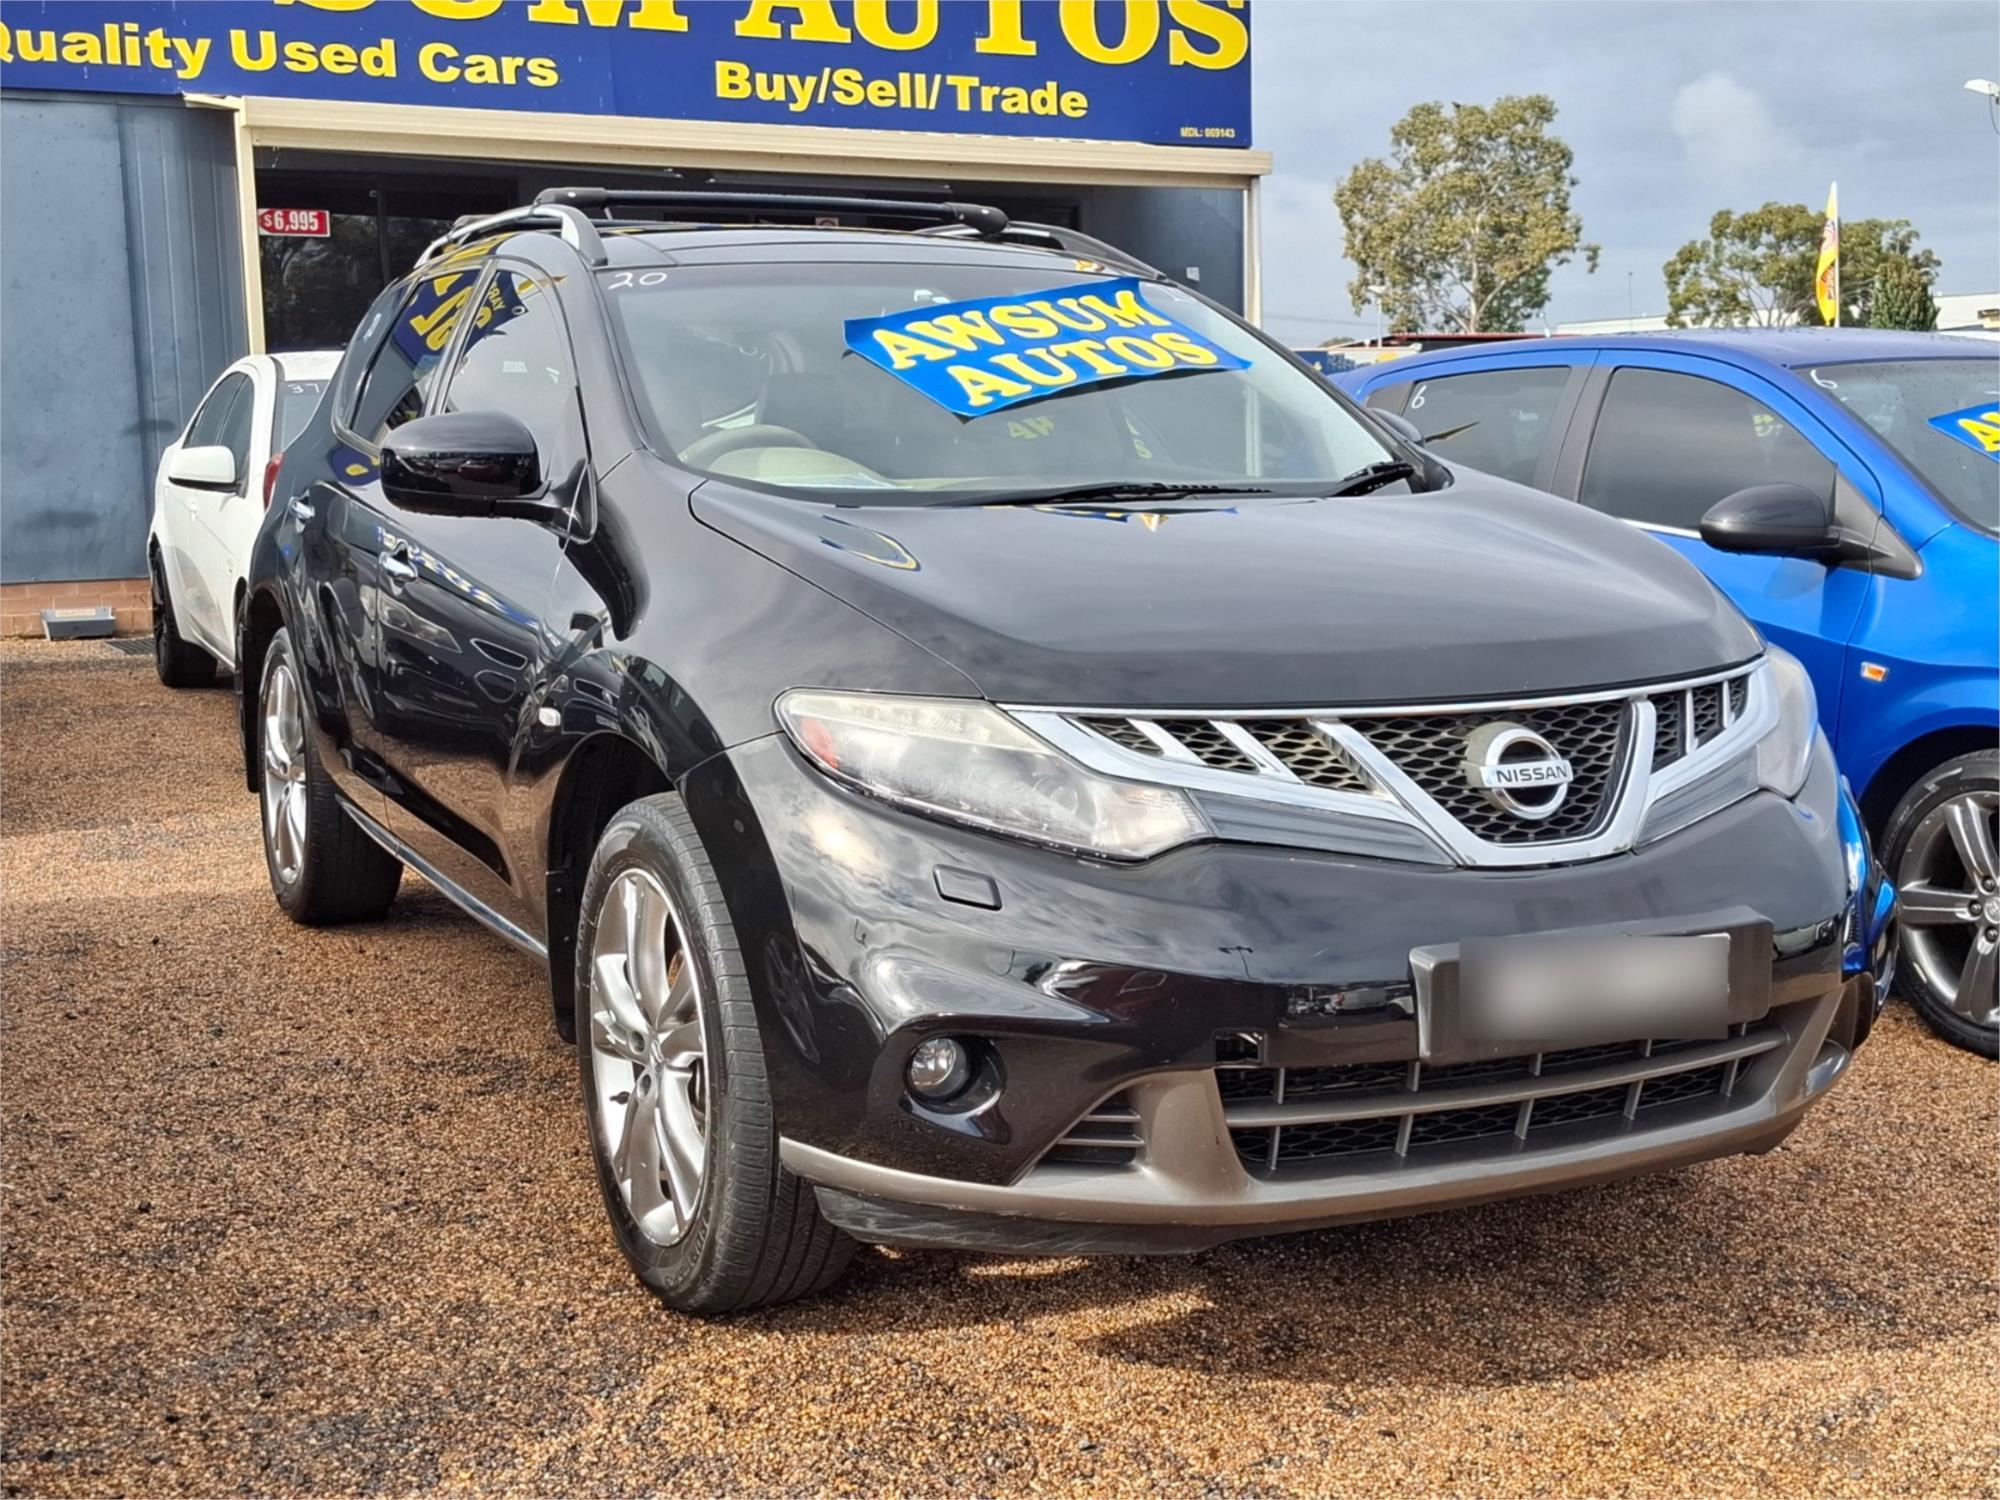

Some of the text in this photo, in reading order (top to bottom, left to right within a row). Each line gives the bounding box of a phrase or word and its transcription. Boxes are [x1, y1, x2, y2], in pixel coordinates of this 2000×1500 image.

[230, 29, 397, 78] Used
[417, 42, 560, 88] Cars
[263, 210, 319, 232] $6,995
[608, 272, 668, 290] 20
[873, 289, 1172, 369] AWSUM
[946, 331, 1219, 406] AUTOS
[1810, 369, 1839, 389] 6
[1411, 385, 1427, 409] 6
[1496, 764, 1568, 784] NISSAN
